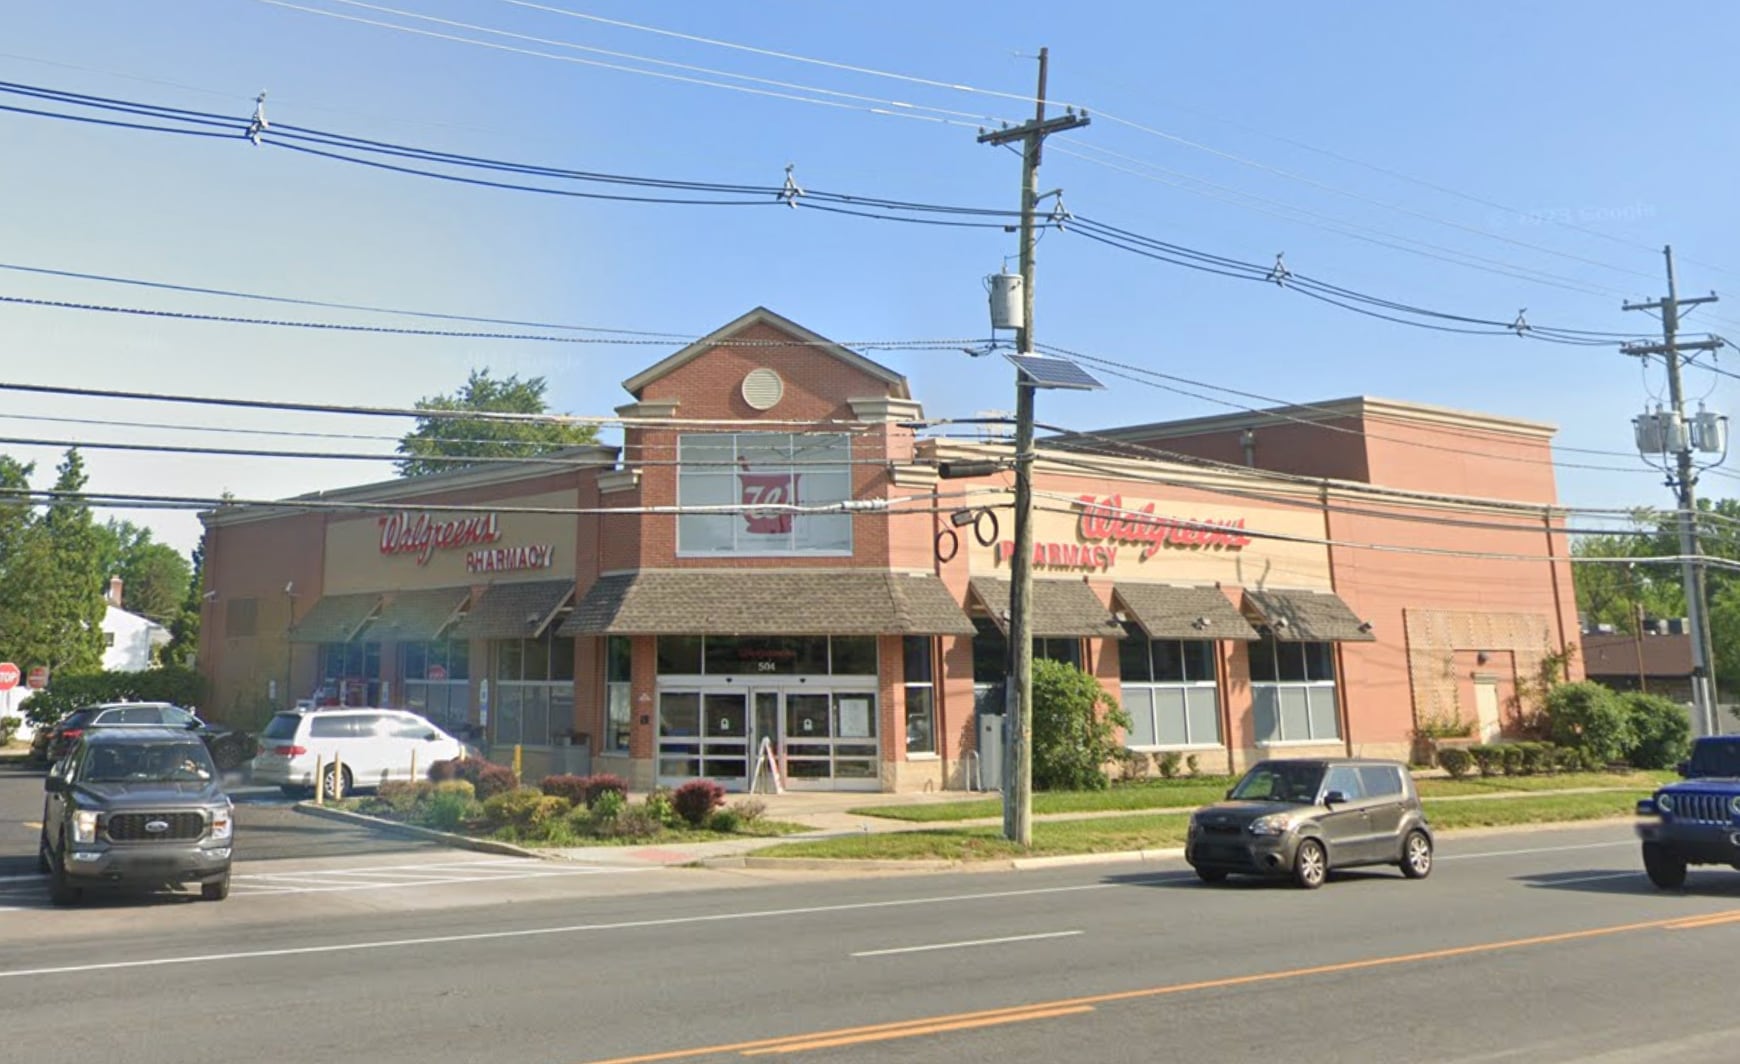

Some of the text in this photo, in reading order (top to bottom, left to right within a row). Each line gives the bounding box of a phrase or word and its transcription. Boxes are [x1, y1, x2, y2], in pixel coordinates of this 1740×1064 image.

[379, 512, 500, 566] Walgreens
[1078, 493, 1252, 558] Walgreens
[466, 544, 553, 573] PHARMACY
[1000, 540, 1118, 568] PARMACY
[757, 661, 776, 672] 504
